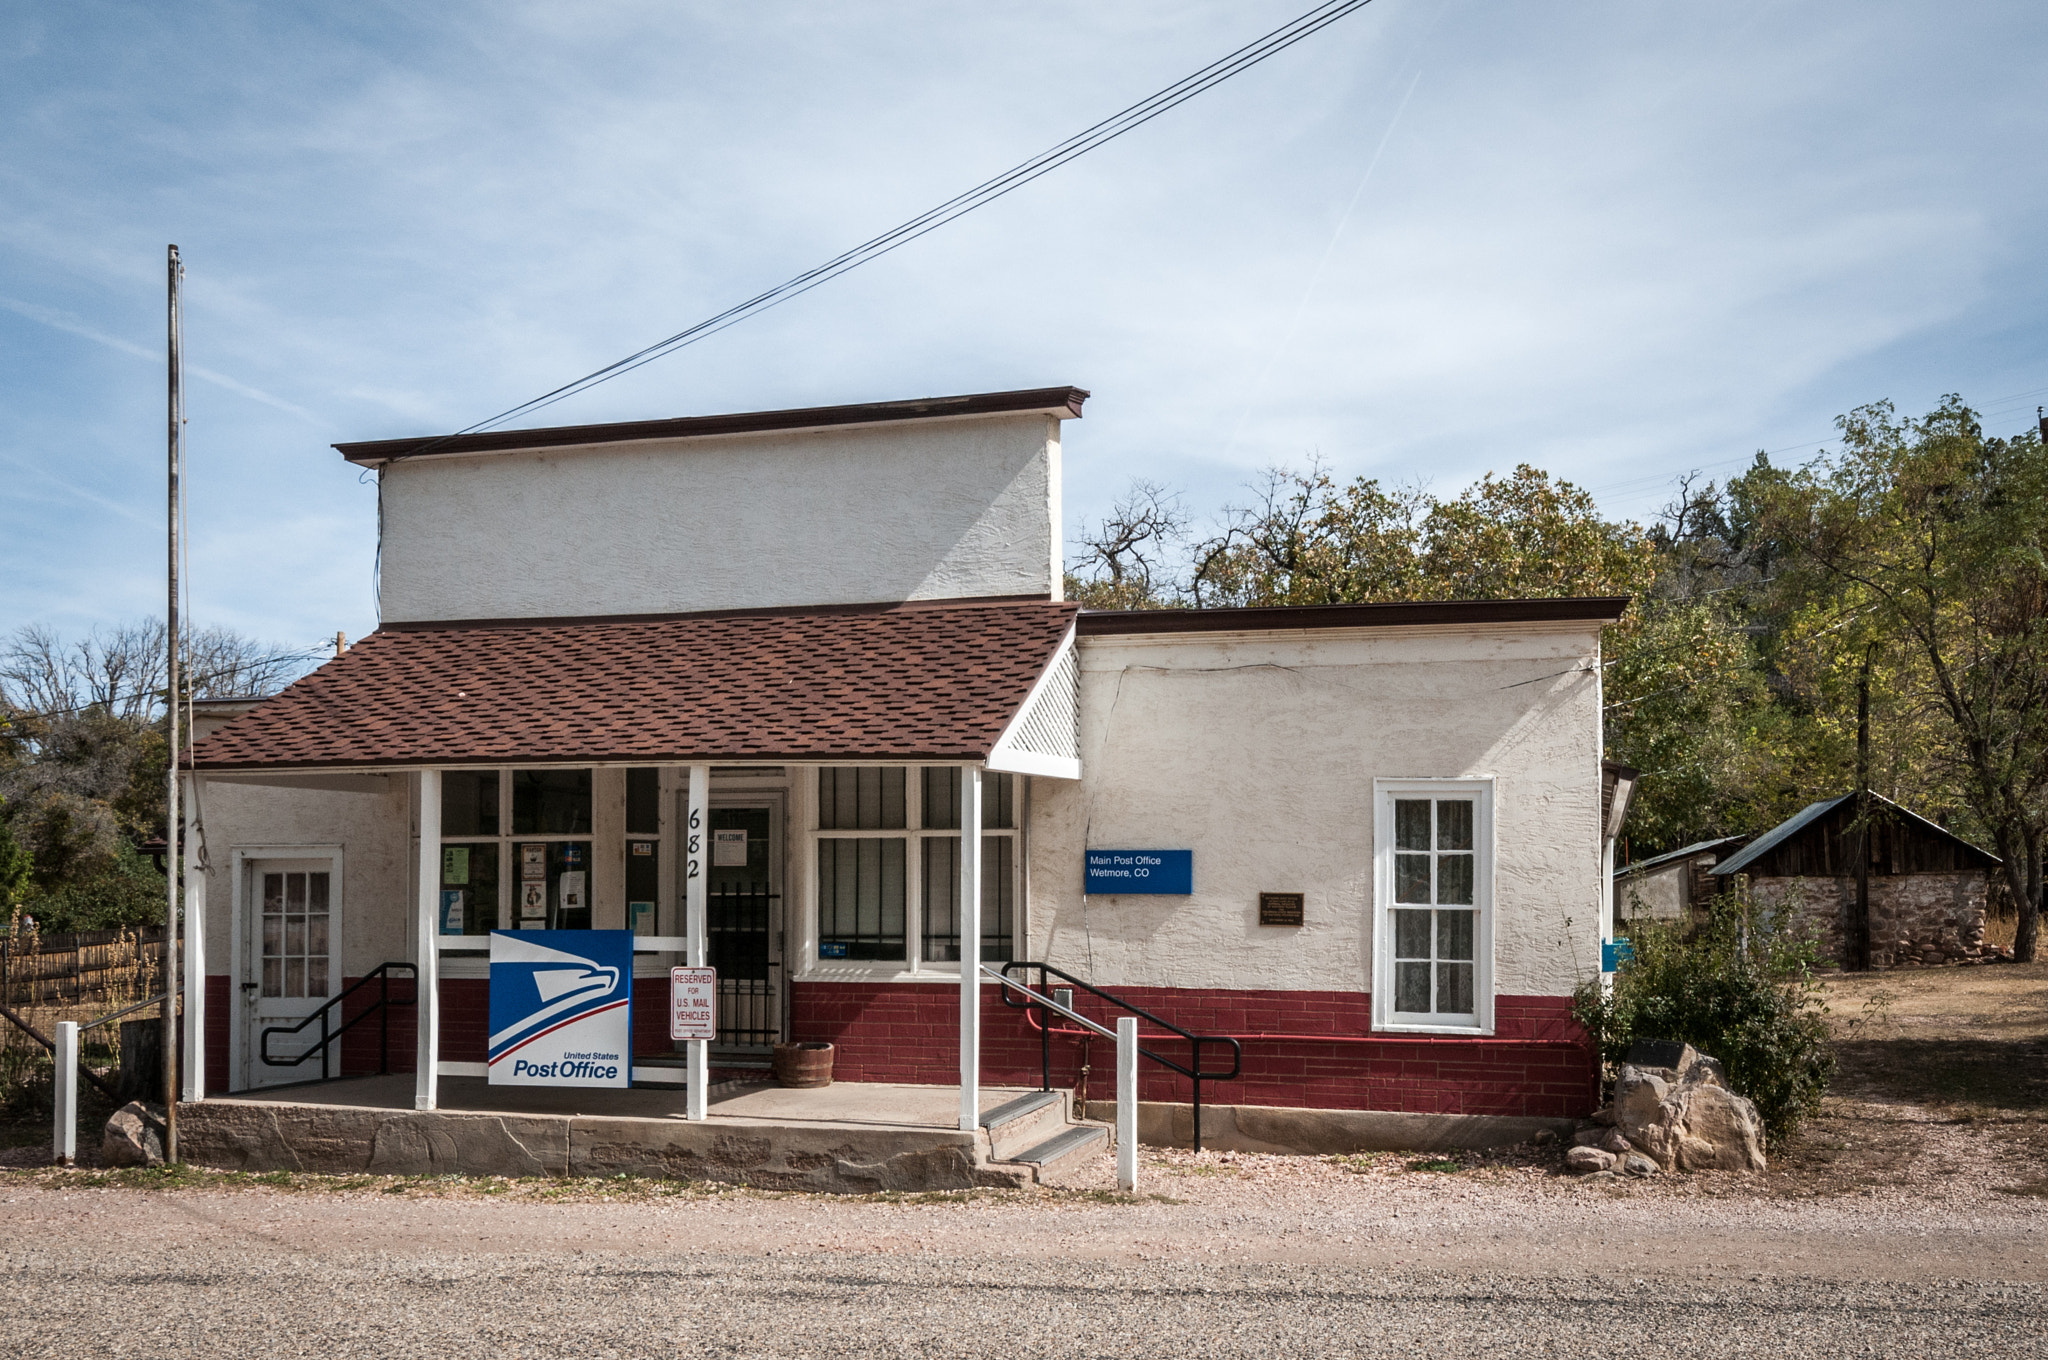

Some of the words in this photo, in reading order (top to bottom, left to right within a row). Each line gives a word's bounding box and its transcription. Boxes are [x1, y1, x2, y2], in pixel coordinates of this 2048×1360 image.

[717, 833, 744, 841] WELCOME
[688, 808, 700, 879] 682
[1090, 856, 1111, 865] Main
[1113, 856, 1133, 865] Post
[1135, 856, 1161, 865] Office
[1090, 868, 1132, 878] Wetmore,
[1134, 868, 1150, 877] CO
[675, 974, 712, 984] RESERVED
[692, 998, 710, 1008] MAIL
[676, 1011, 710, 1020] VEHICLES
[563, 1052, 591, 1060] United
[592, 1052, 619, 1060] States
[513, 1060, 558, 1078] Post
[559, 1061, 618, 1079] Office
